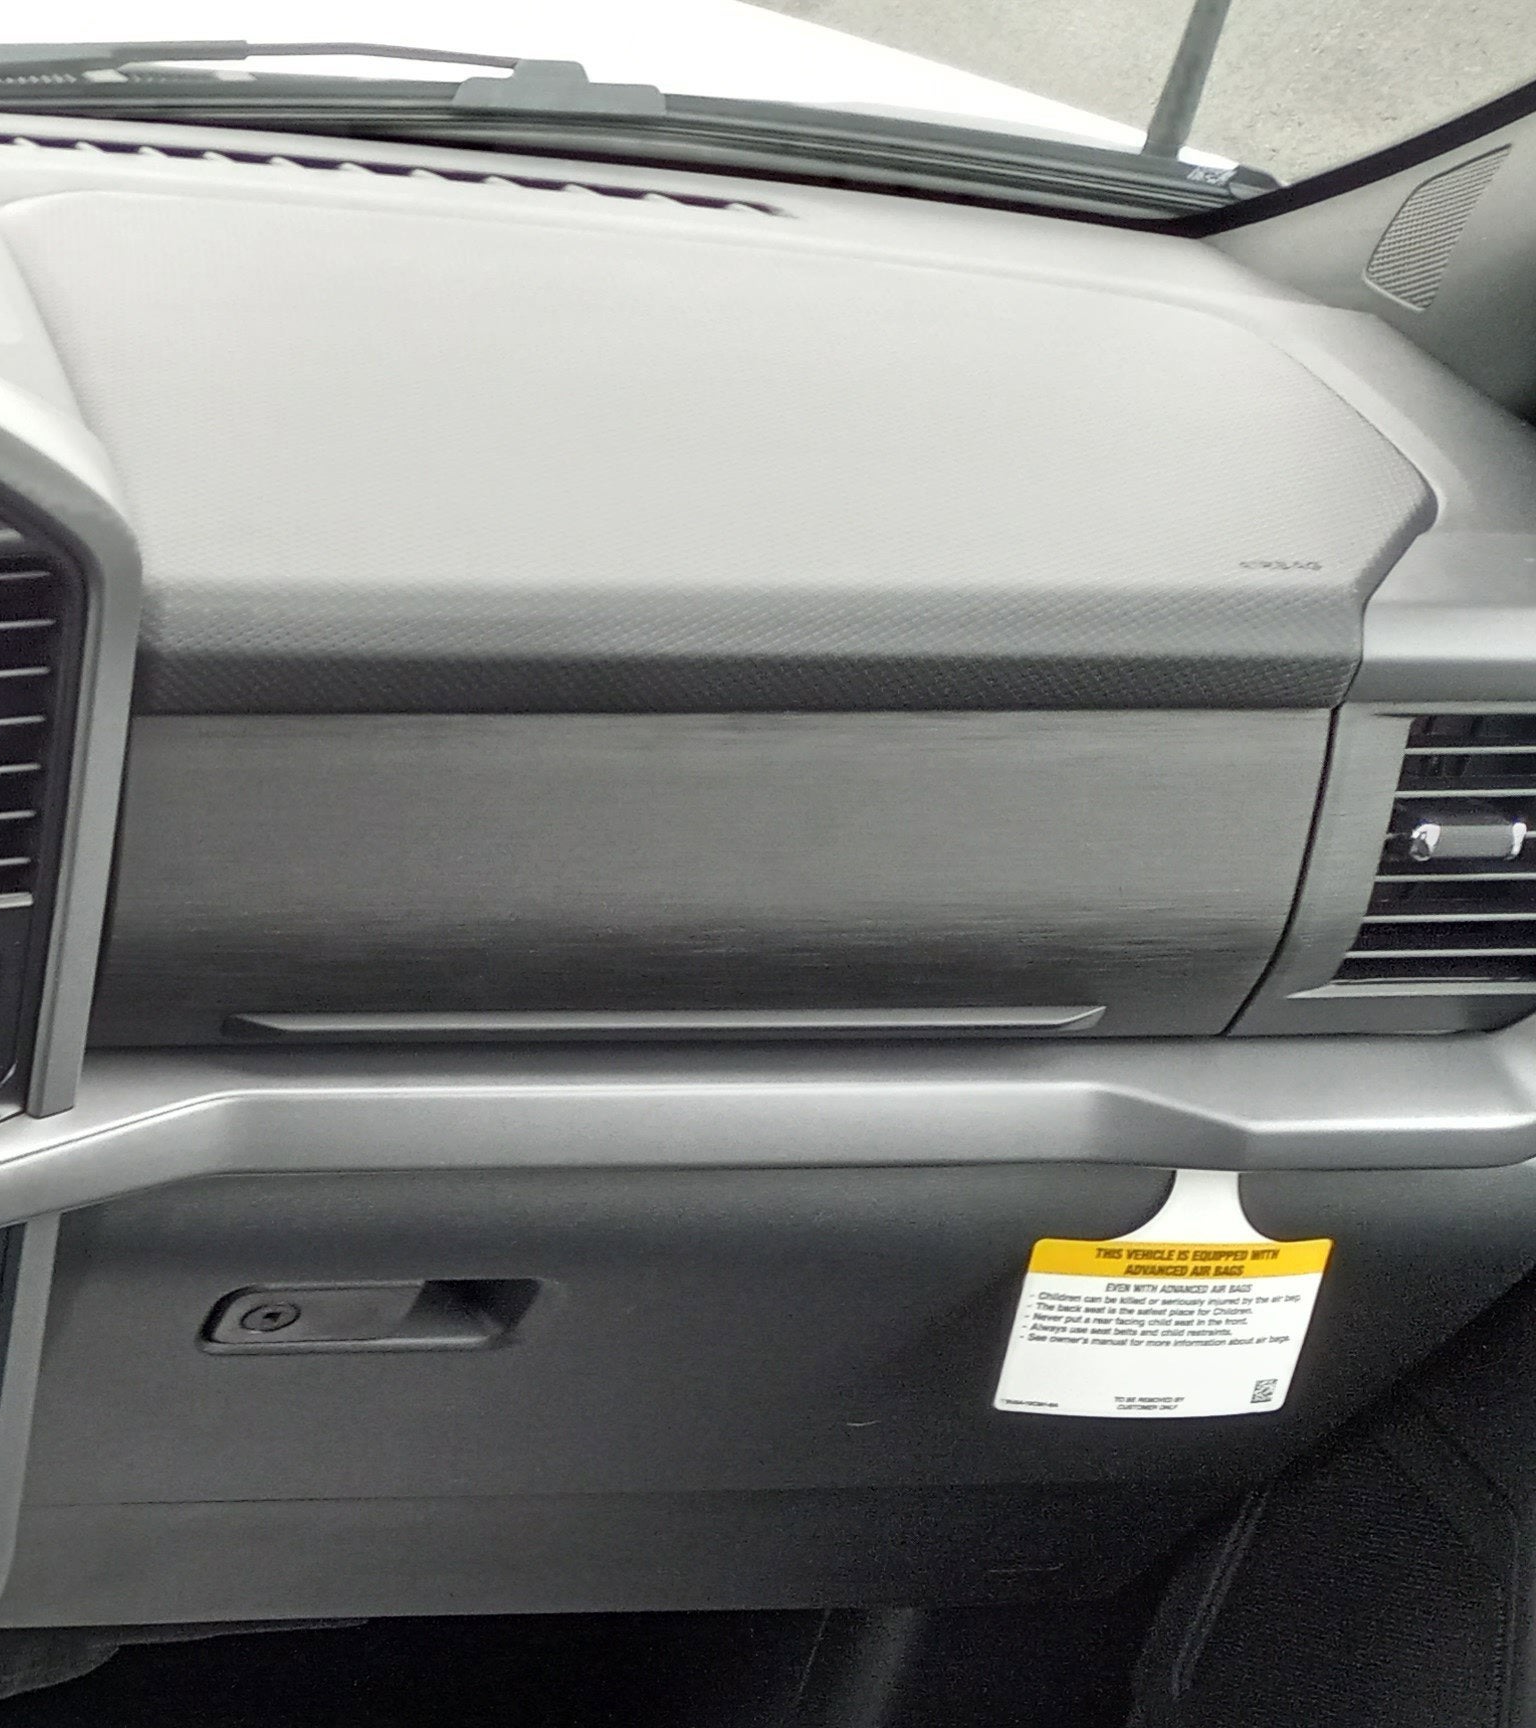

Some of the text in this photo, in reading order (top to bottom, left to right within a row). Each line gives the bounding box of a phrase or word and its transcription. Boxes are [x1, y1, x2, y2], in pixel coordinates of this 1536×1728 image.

[1095, 1248, 1280, 1261] THIS VEHICLE IS EQUIPPED WITH
[1123, 1265, 1244, 1276] ADVANCED AIR BAGS
[1159, 1285, 1209, 1294] ADVANCED
[1038, 1292, 1081, 1302] Children
[1036, 1302, 1055, 1311] The
[1027, 1333, 1047, 1342] See
